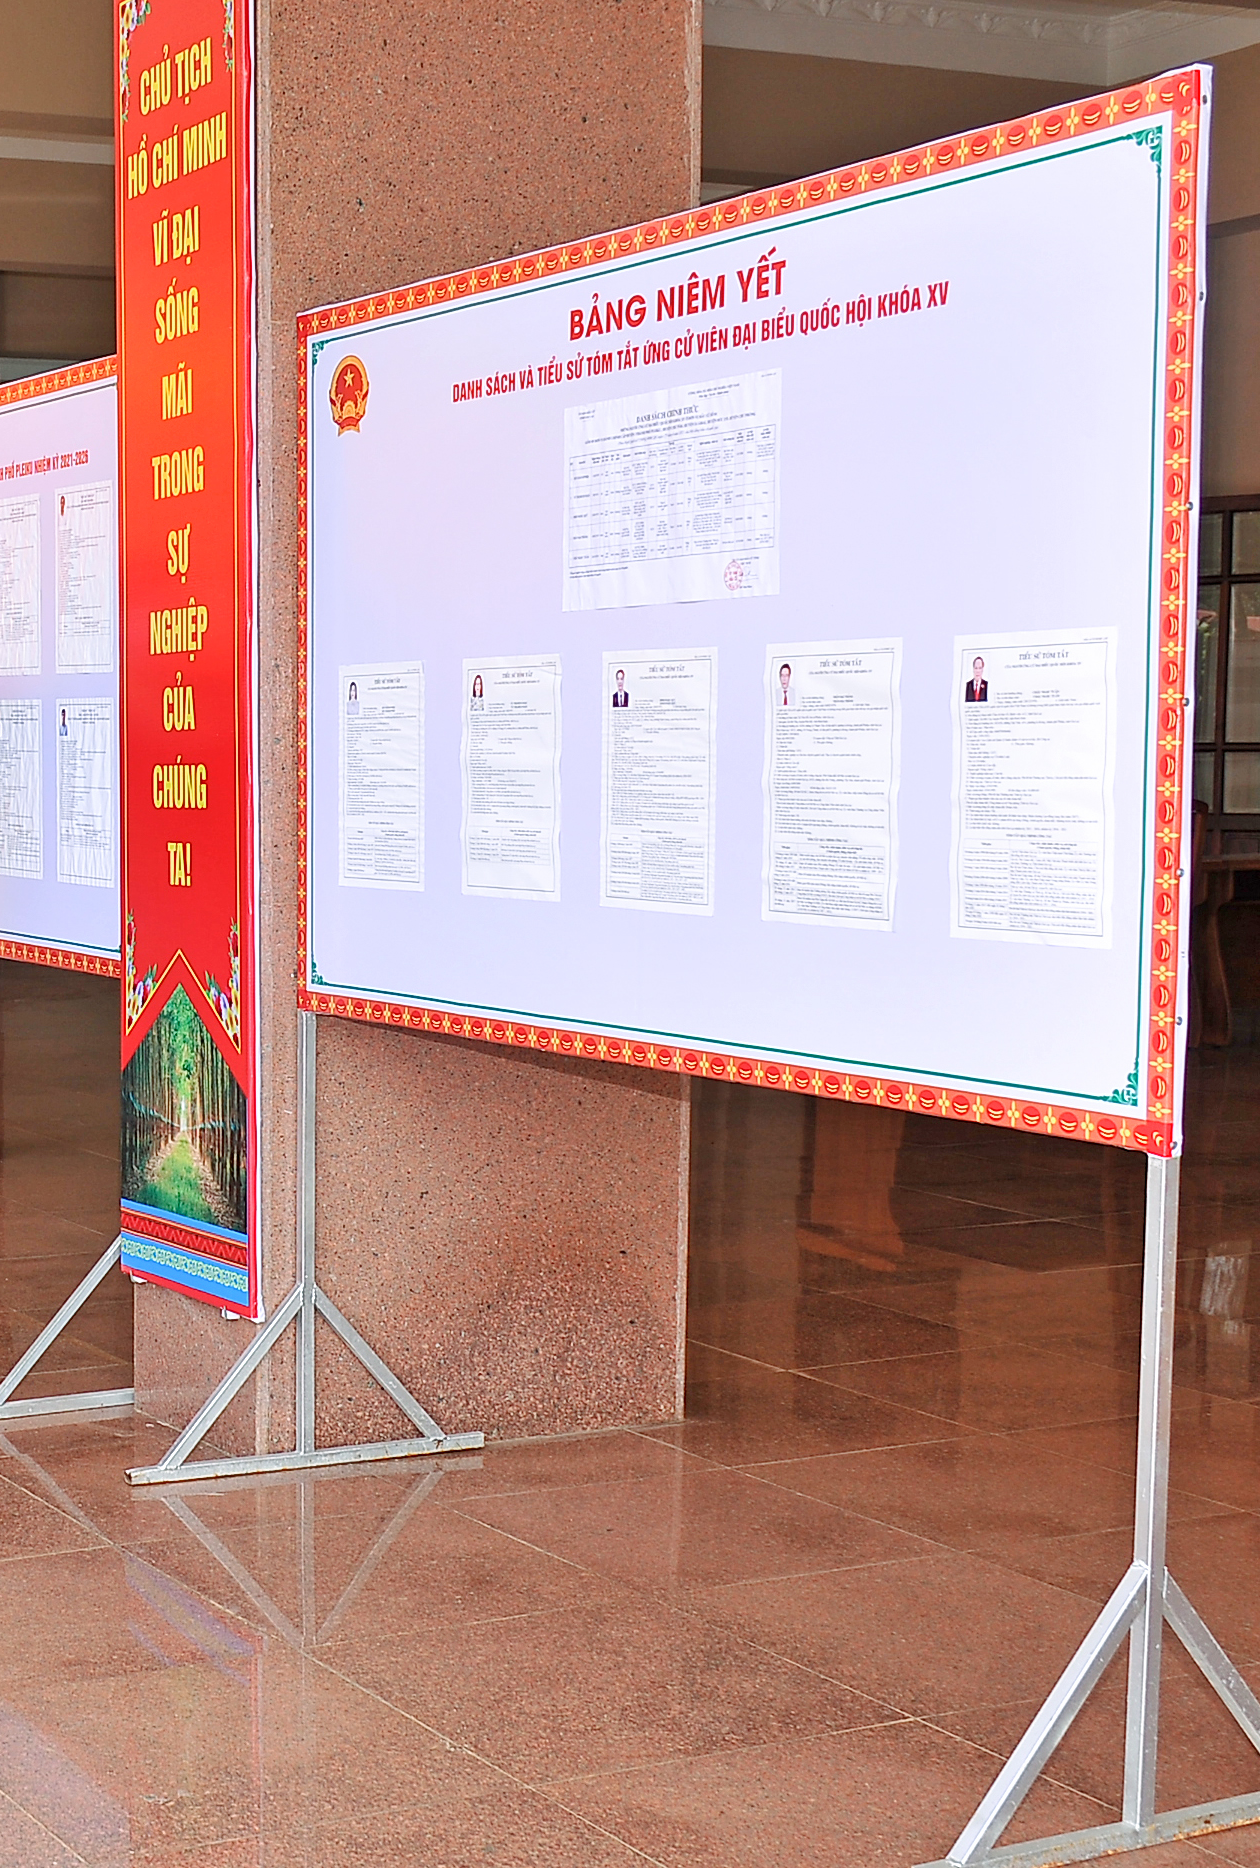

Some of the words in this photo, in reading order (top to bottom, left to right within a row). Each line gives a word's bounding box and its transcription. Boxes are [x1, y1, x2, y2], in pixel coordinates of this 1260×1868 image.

[139, 44, 172, 116] CHỦ
[174, 37, 213, 105] TỊCH
[127, 134, 148, 200] HỒ
[152, 125, 179, 189] CHÍ
[183, 111, 228, 176] MINH
[152, 209, 169, 267] VĨ
[171, 205, 200, 265] ĐẠI
[154, 278, 199, 344] SỐNG
[570, 292, 646, 341] BẢNG
[656, 272, 725, 321] NIÊM
[737, 246, 786, 303] YẾT
[453, 379, 482, 403] DANH
[486, 371, 516, 396] SÁCH
[519, 365, 534, 390] VÀ
[538, 356, 562, 386] TIỂU
[567, 352, 584, 380] SỬ
[587, 351, 613, 376] TÓM
[617, 341, 639, 370] TẮT
[643, 340, 670, 365] ỨNG
[674, 329, 694, 359] CỬ
[697, 326, 728, 354] VIÊN
[732, 322, 756, 350] ĐẠI
[761, 307, 794, 341] BIỂU
[799, 298, 840, 335] QUỐC
[846, 294, 872, 327] HỘI
[877, 285, 921, 318] KHÓA
[926, 281, 949, 309] XV
[161, 362, 193, 420] MÃI
[151, 445, 205, 500] TRONG
[167, 523, 191, 583] SỰ
[149, 597, 208, 661] NGHIỆP
[163, 671, 196, 731] CỦA
[153, 755, 207, 809] CHÚNG
[167, 842, 192, 887] TA!
